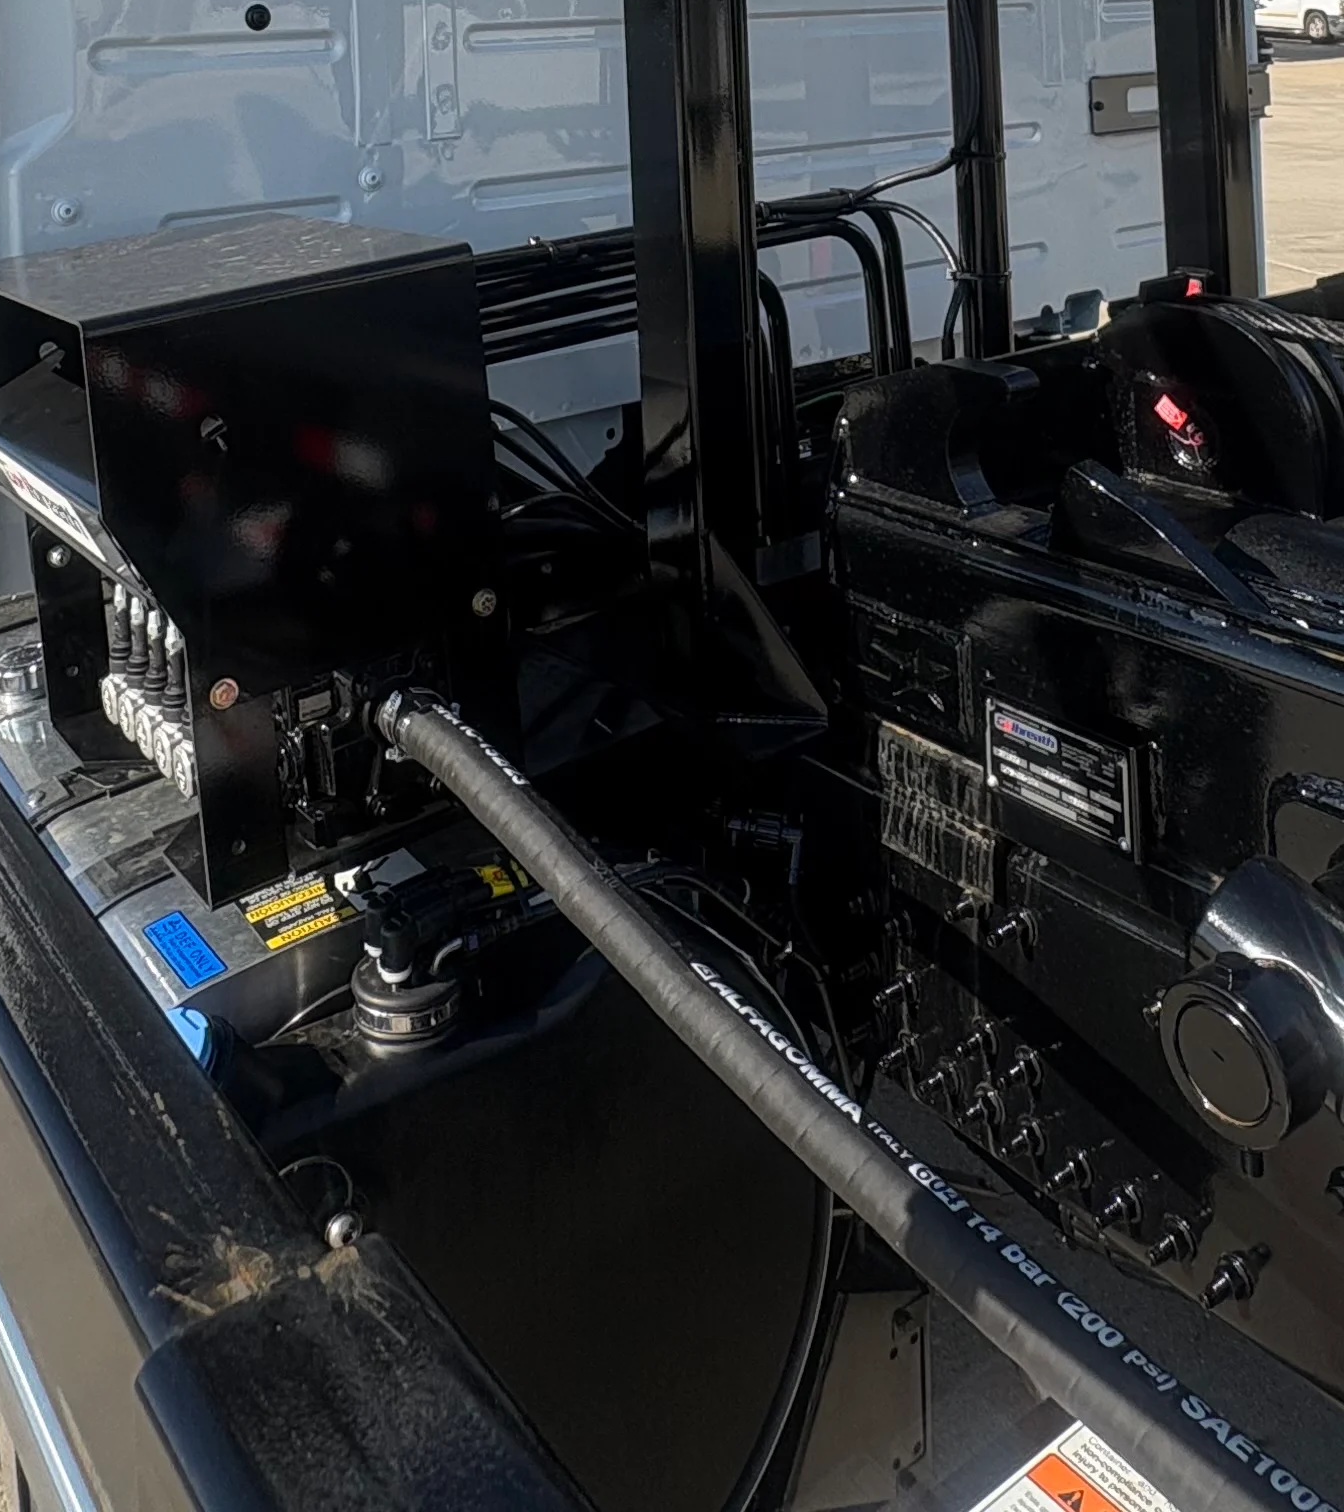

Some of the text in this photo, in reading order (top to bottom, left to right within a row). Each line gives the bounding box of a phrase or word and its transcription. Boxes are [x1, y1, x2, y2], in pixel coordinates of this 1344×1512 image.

[249, 885, 325, 920] RECAUCIÓN
[280, 913, 340, 942] CAUTION
[189, 949, 216, 974] ONLY
[709, 980, 863, 1124] ALFAGOMMA
[867, 1121, 914, 1161] ITALY
[965, 1214, 1004, 1243] 14
[1001, 1243, 1056, 1287] bar
[1057, 1291, 1125, 1348] (200
[1122, 1349, 1178, 1392] psi)
[1087, 1435, 1132, 1476] Container
[1080, 1442, 1153, 1507] Non-compliance
[1097, 1471, 1110, 1484] to
